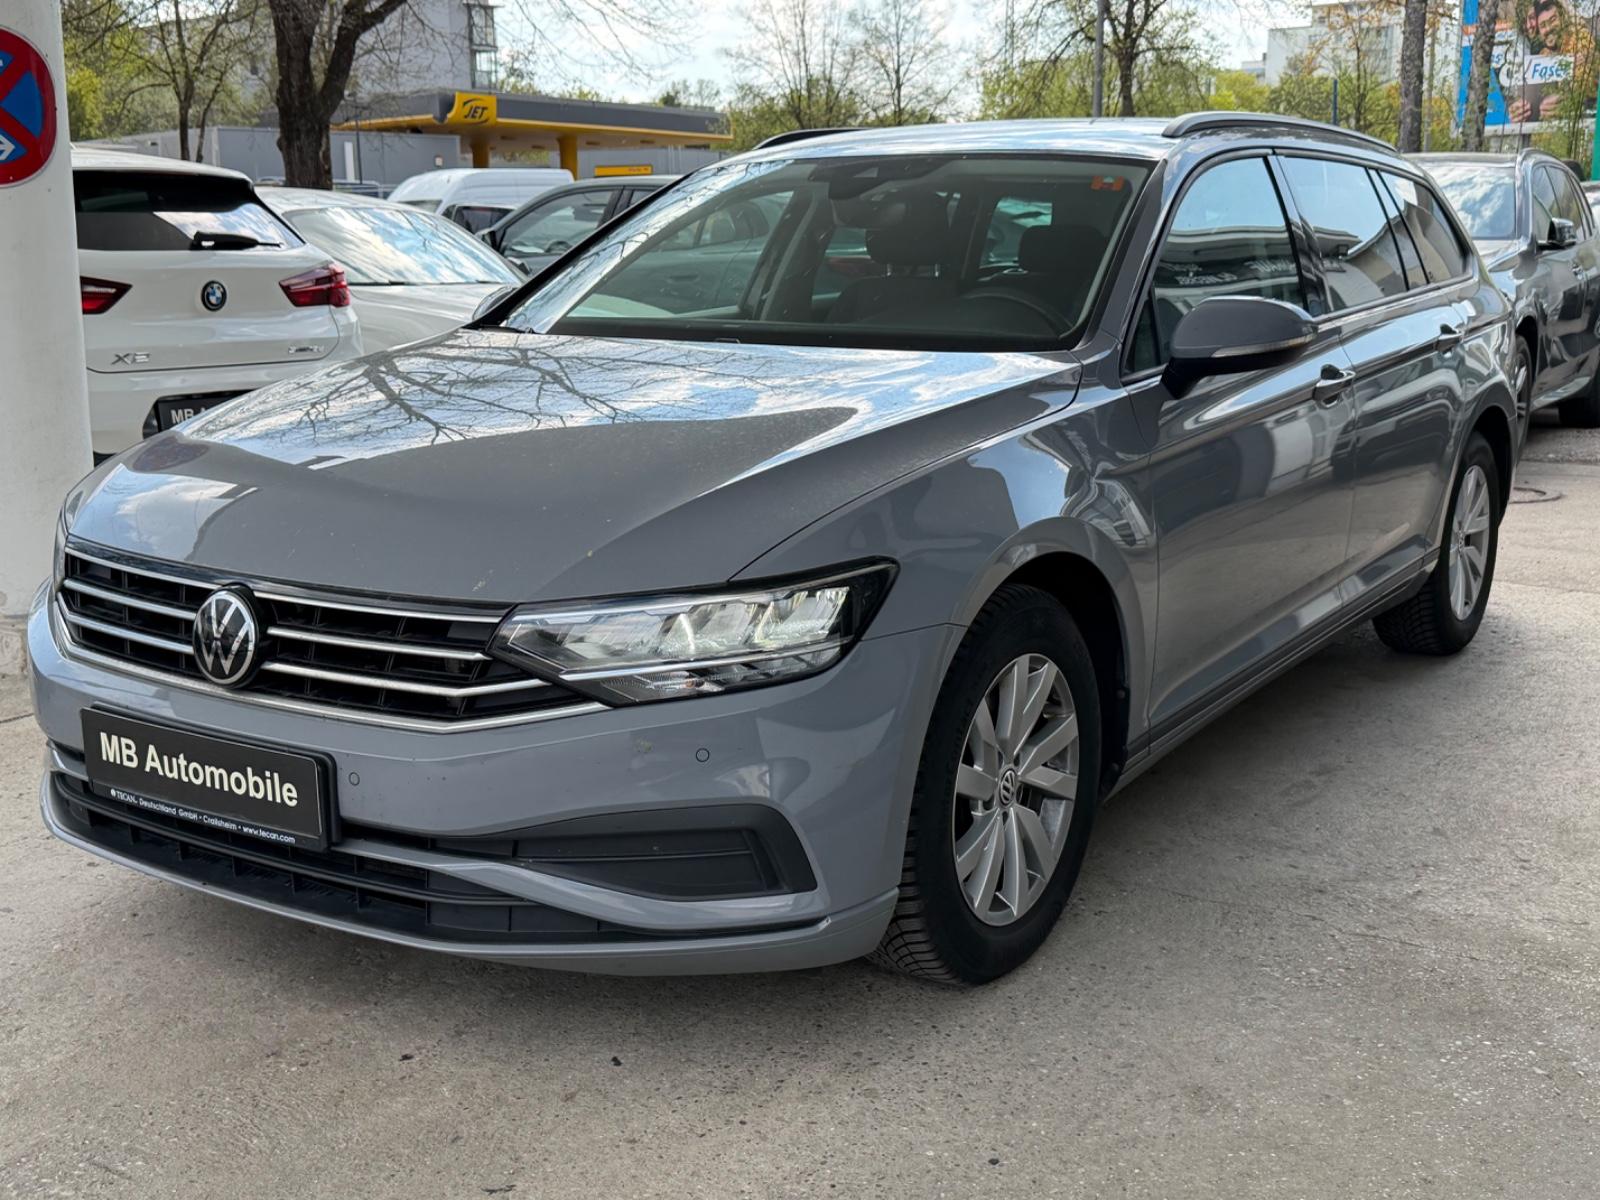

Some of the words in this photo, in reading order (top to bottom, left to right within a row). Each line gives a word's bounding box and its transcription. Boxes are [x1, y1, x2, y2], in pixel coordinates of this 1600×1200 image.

[464, 105, 488, 119] JET
[100, 731, 139, 769] MB
[144, 744, 298, 808] Automobile
[139, 798, 177, 815] Deutschland
[178, 808, 198, 821] GmbH
[203, 814, 237, 831] Crailsheim
